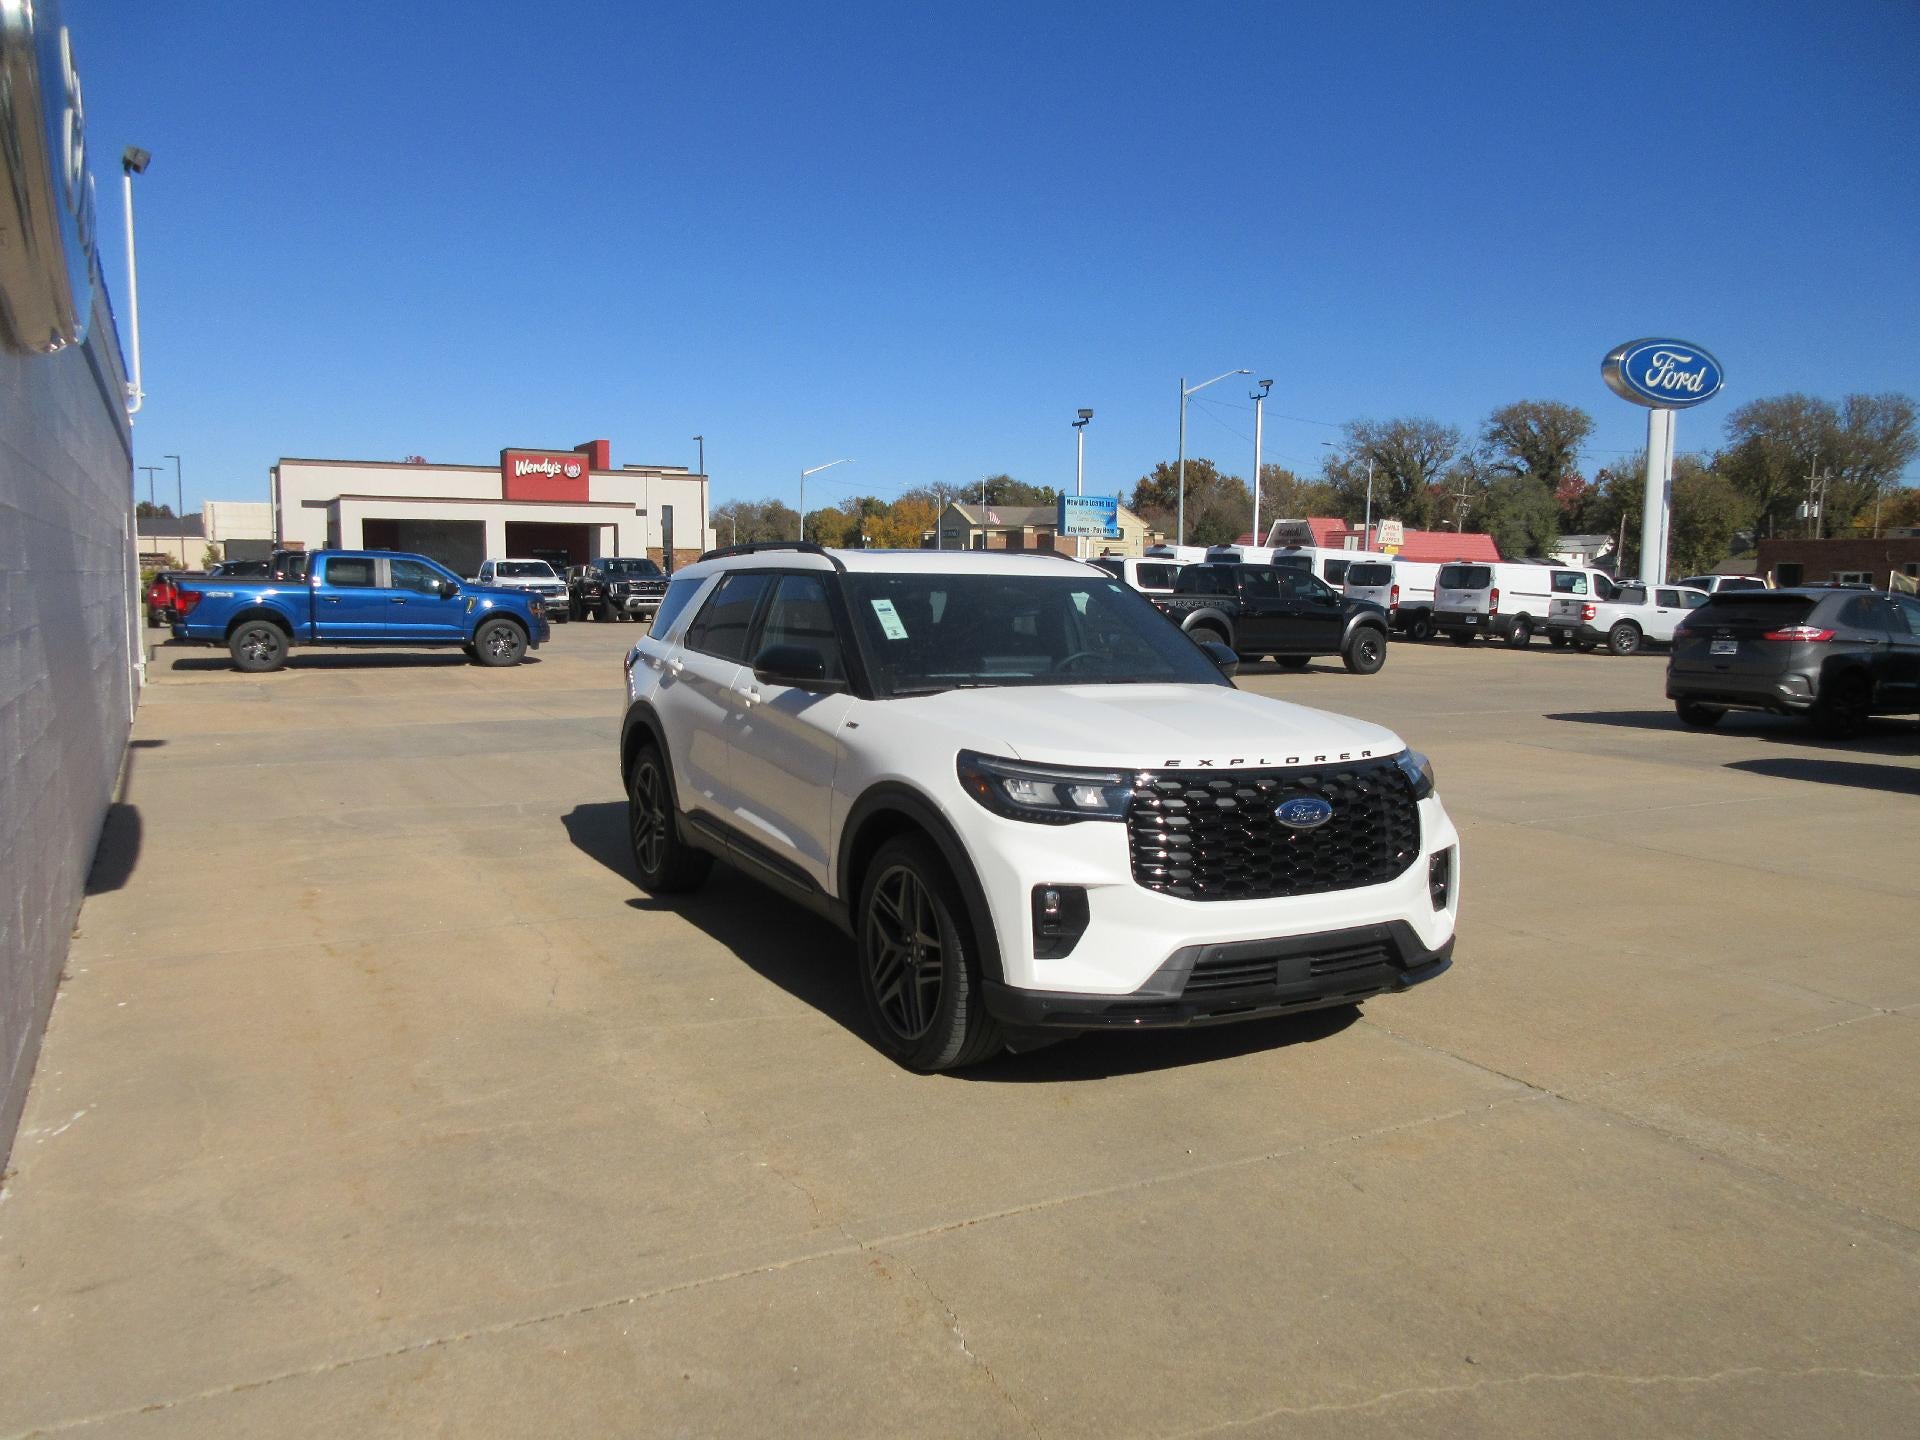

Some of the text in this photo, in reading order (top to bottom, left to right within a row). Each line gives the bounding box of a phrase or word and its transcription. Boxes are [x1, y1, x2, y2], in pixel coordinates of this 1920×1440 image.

[1645, 351, 1707, 393] Ford
[515, 458, 562, 478] Wendy's
[1066, 498, 1078, 506] New
[1089, 499, 1105, 507] Loans
[1078, 526, 1090, 534] Here
[1093, 526, 1102, 534] Pay
[1164, 749, 1372, 767] EXPLORER
[1291, 804, 1321, 819] Ford
